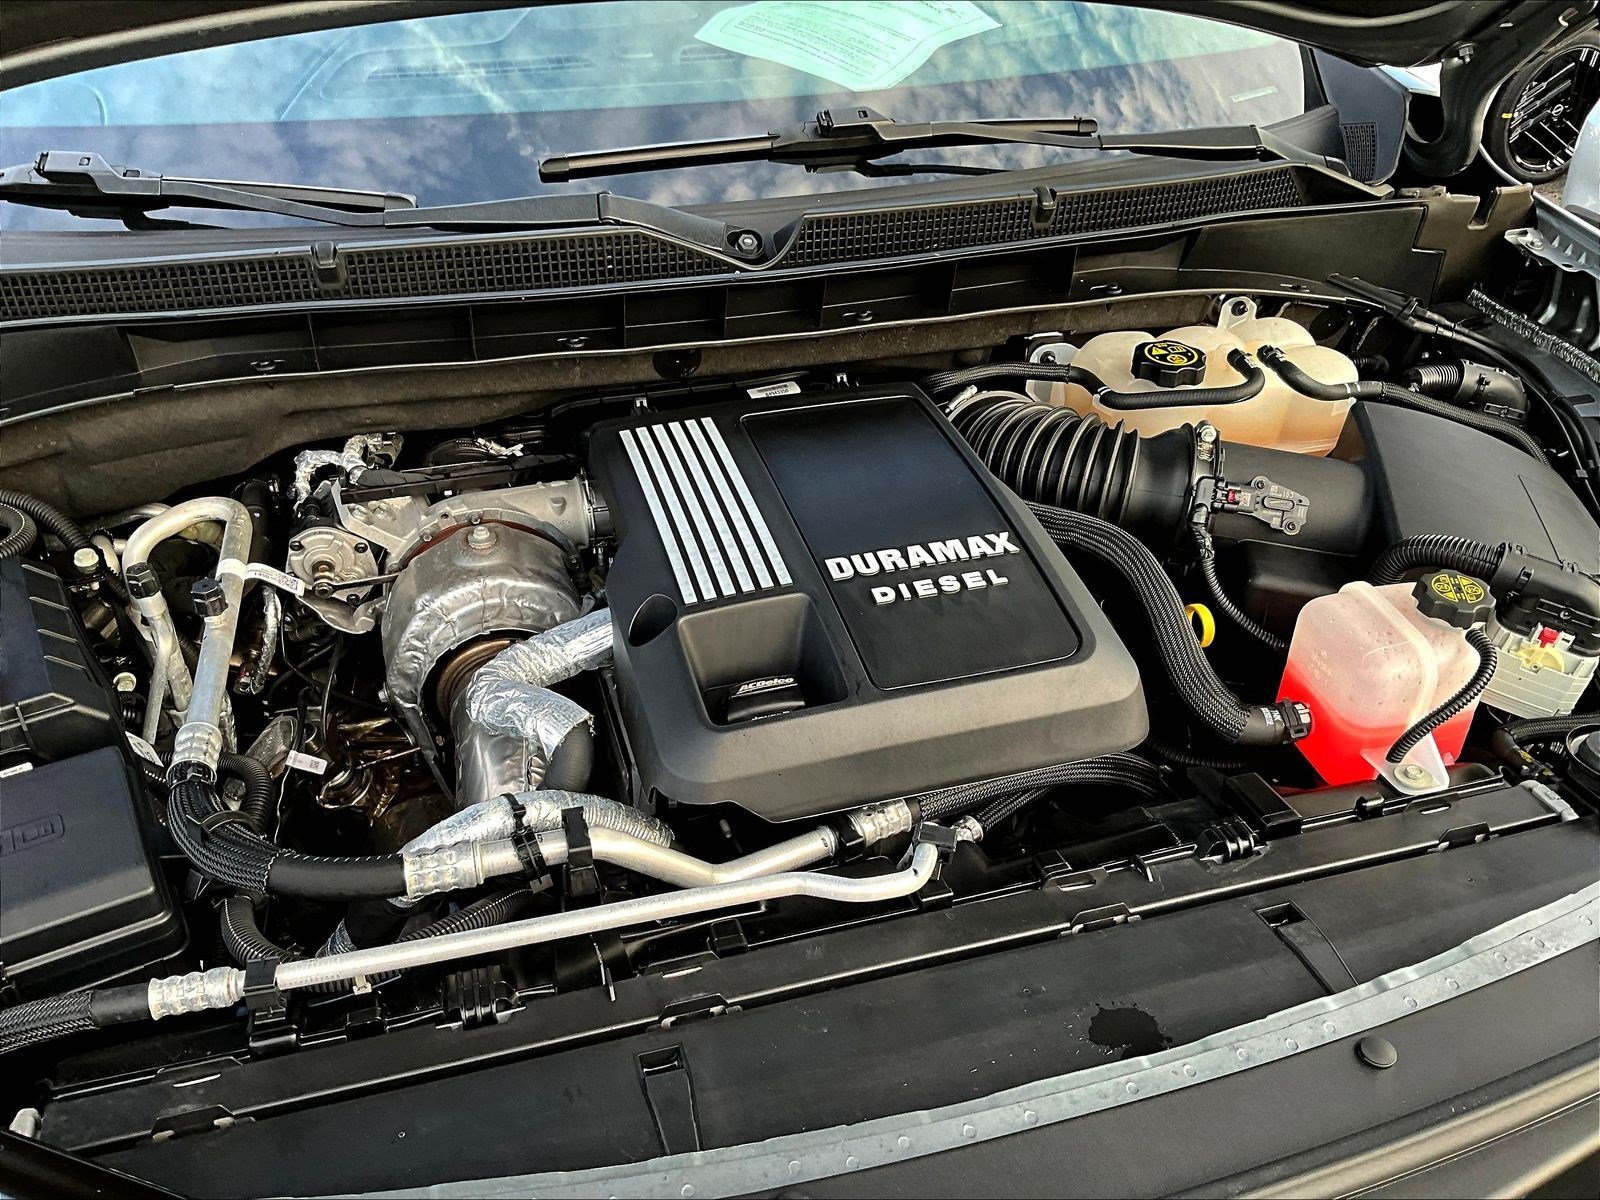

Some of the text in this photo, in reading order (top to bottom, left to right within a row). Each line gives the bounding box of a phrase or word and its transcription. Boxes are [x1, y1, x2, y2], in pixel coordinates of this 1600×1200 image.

[824, 531, 1020, 582] DURAMAX
[871, 569, 1009, 605] DIESEL
[736, 677, 795, 695] ACDelco
